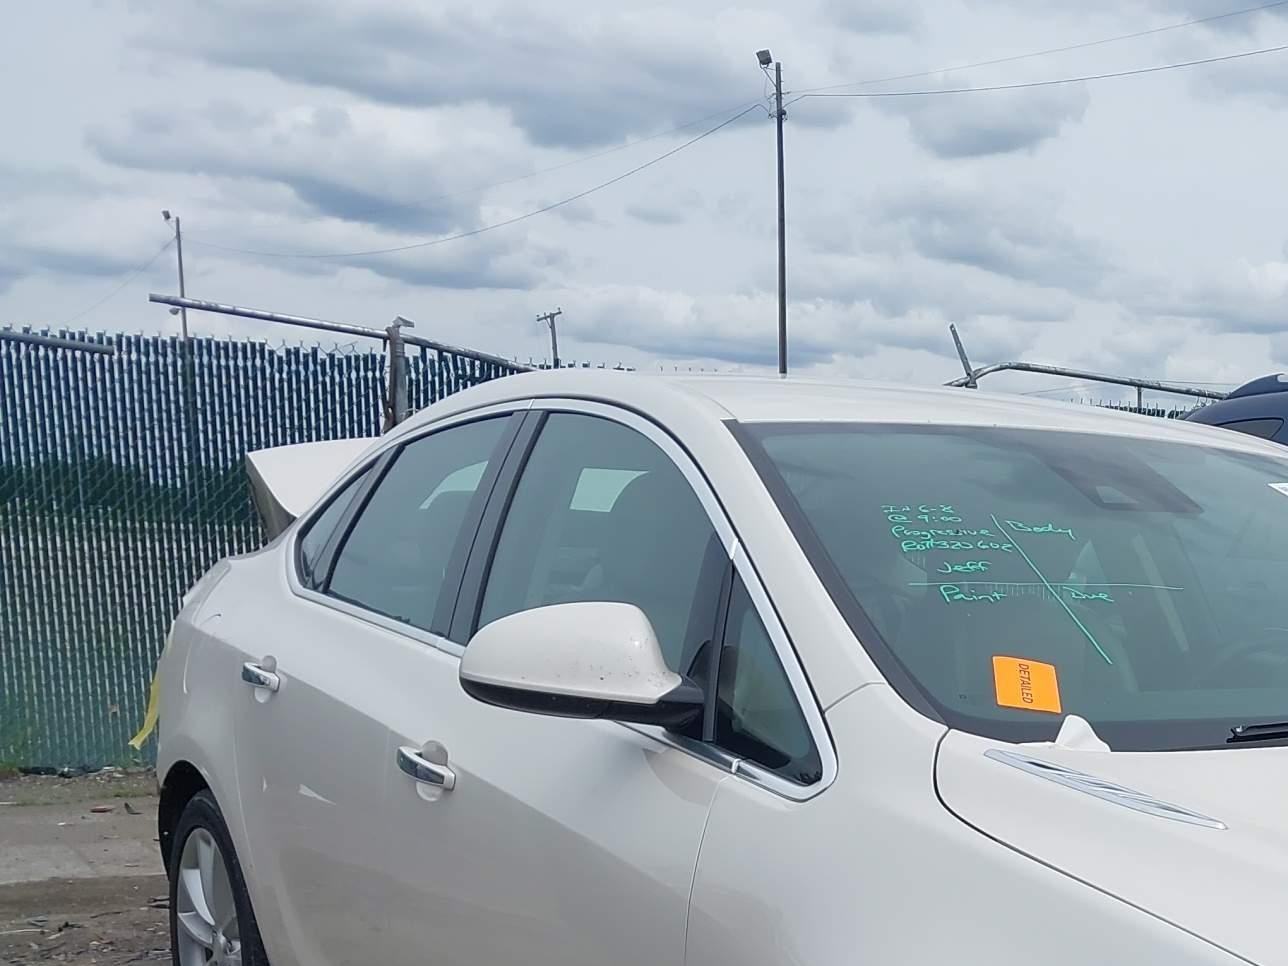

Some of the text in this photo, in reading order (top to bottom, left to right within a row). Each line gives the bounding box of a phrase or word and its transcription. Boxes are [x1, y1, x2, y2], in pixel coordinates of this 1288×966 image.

[1005, 520, 1077, 541] Body
[936, 561, 992, 573] Jeff
[939, 584, 1008, 603] Paint
[1018, 663, 1034, 704] DETAILED
